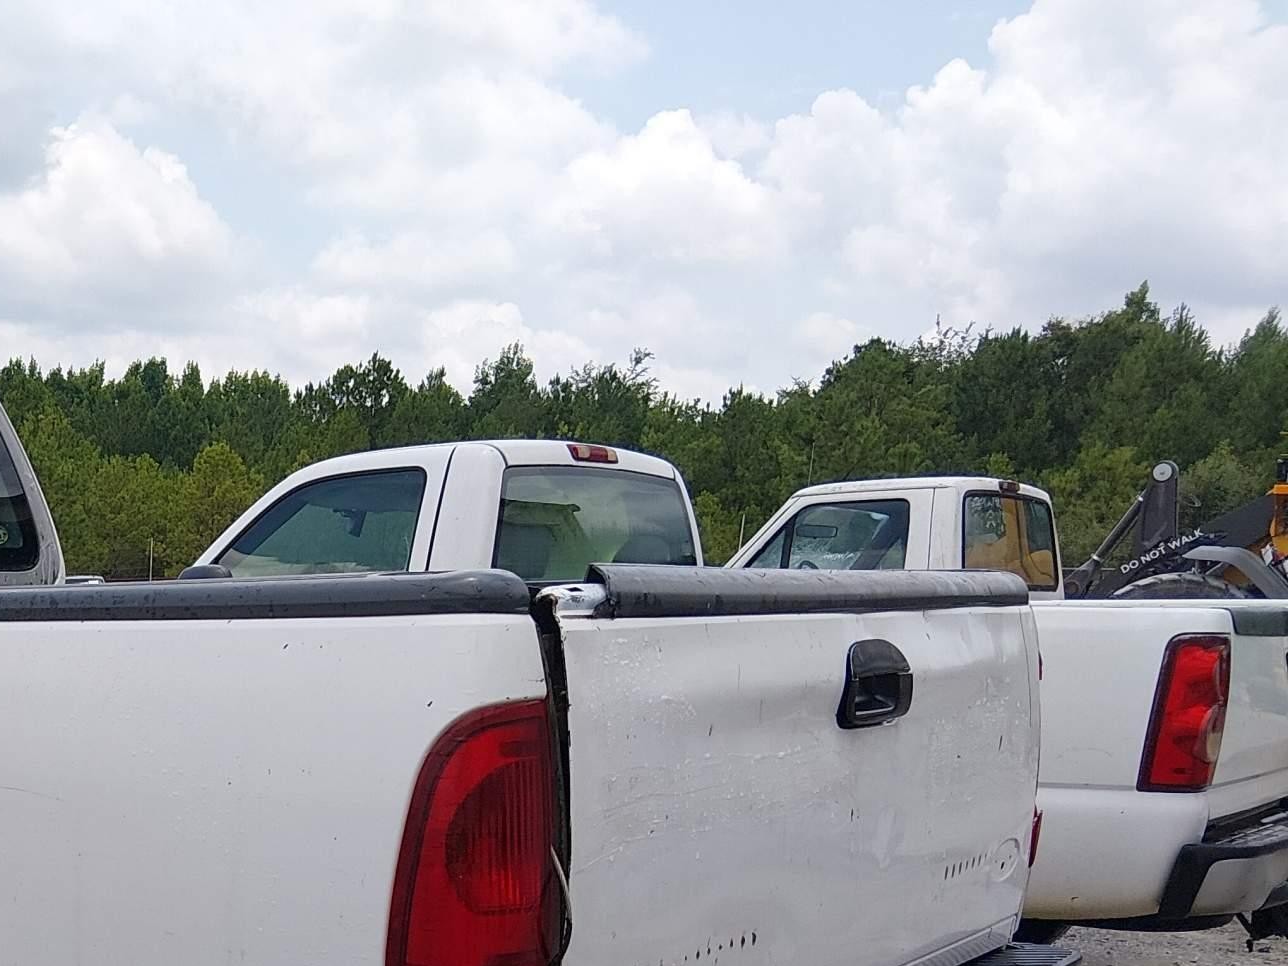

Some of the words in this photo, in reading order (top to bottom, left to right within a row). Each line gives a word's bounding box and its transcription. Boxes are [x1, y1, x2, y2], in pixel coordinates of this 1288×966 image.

[1120, 560, 1139, 574] DO
[1140, 543, 1166, 564] NOT
[1167, 528, 1204, 550] WALK
